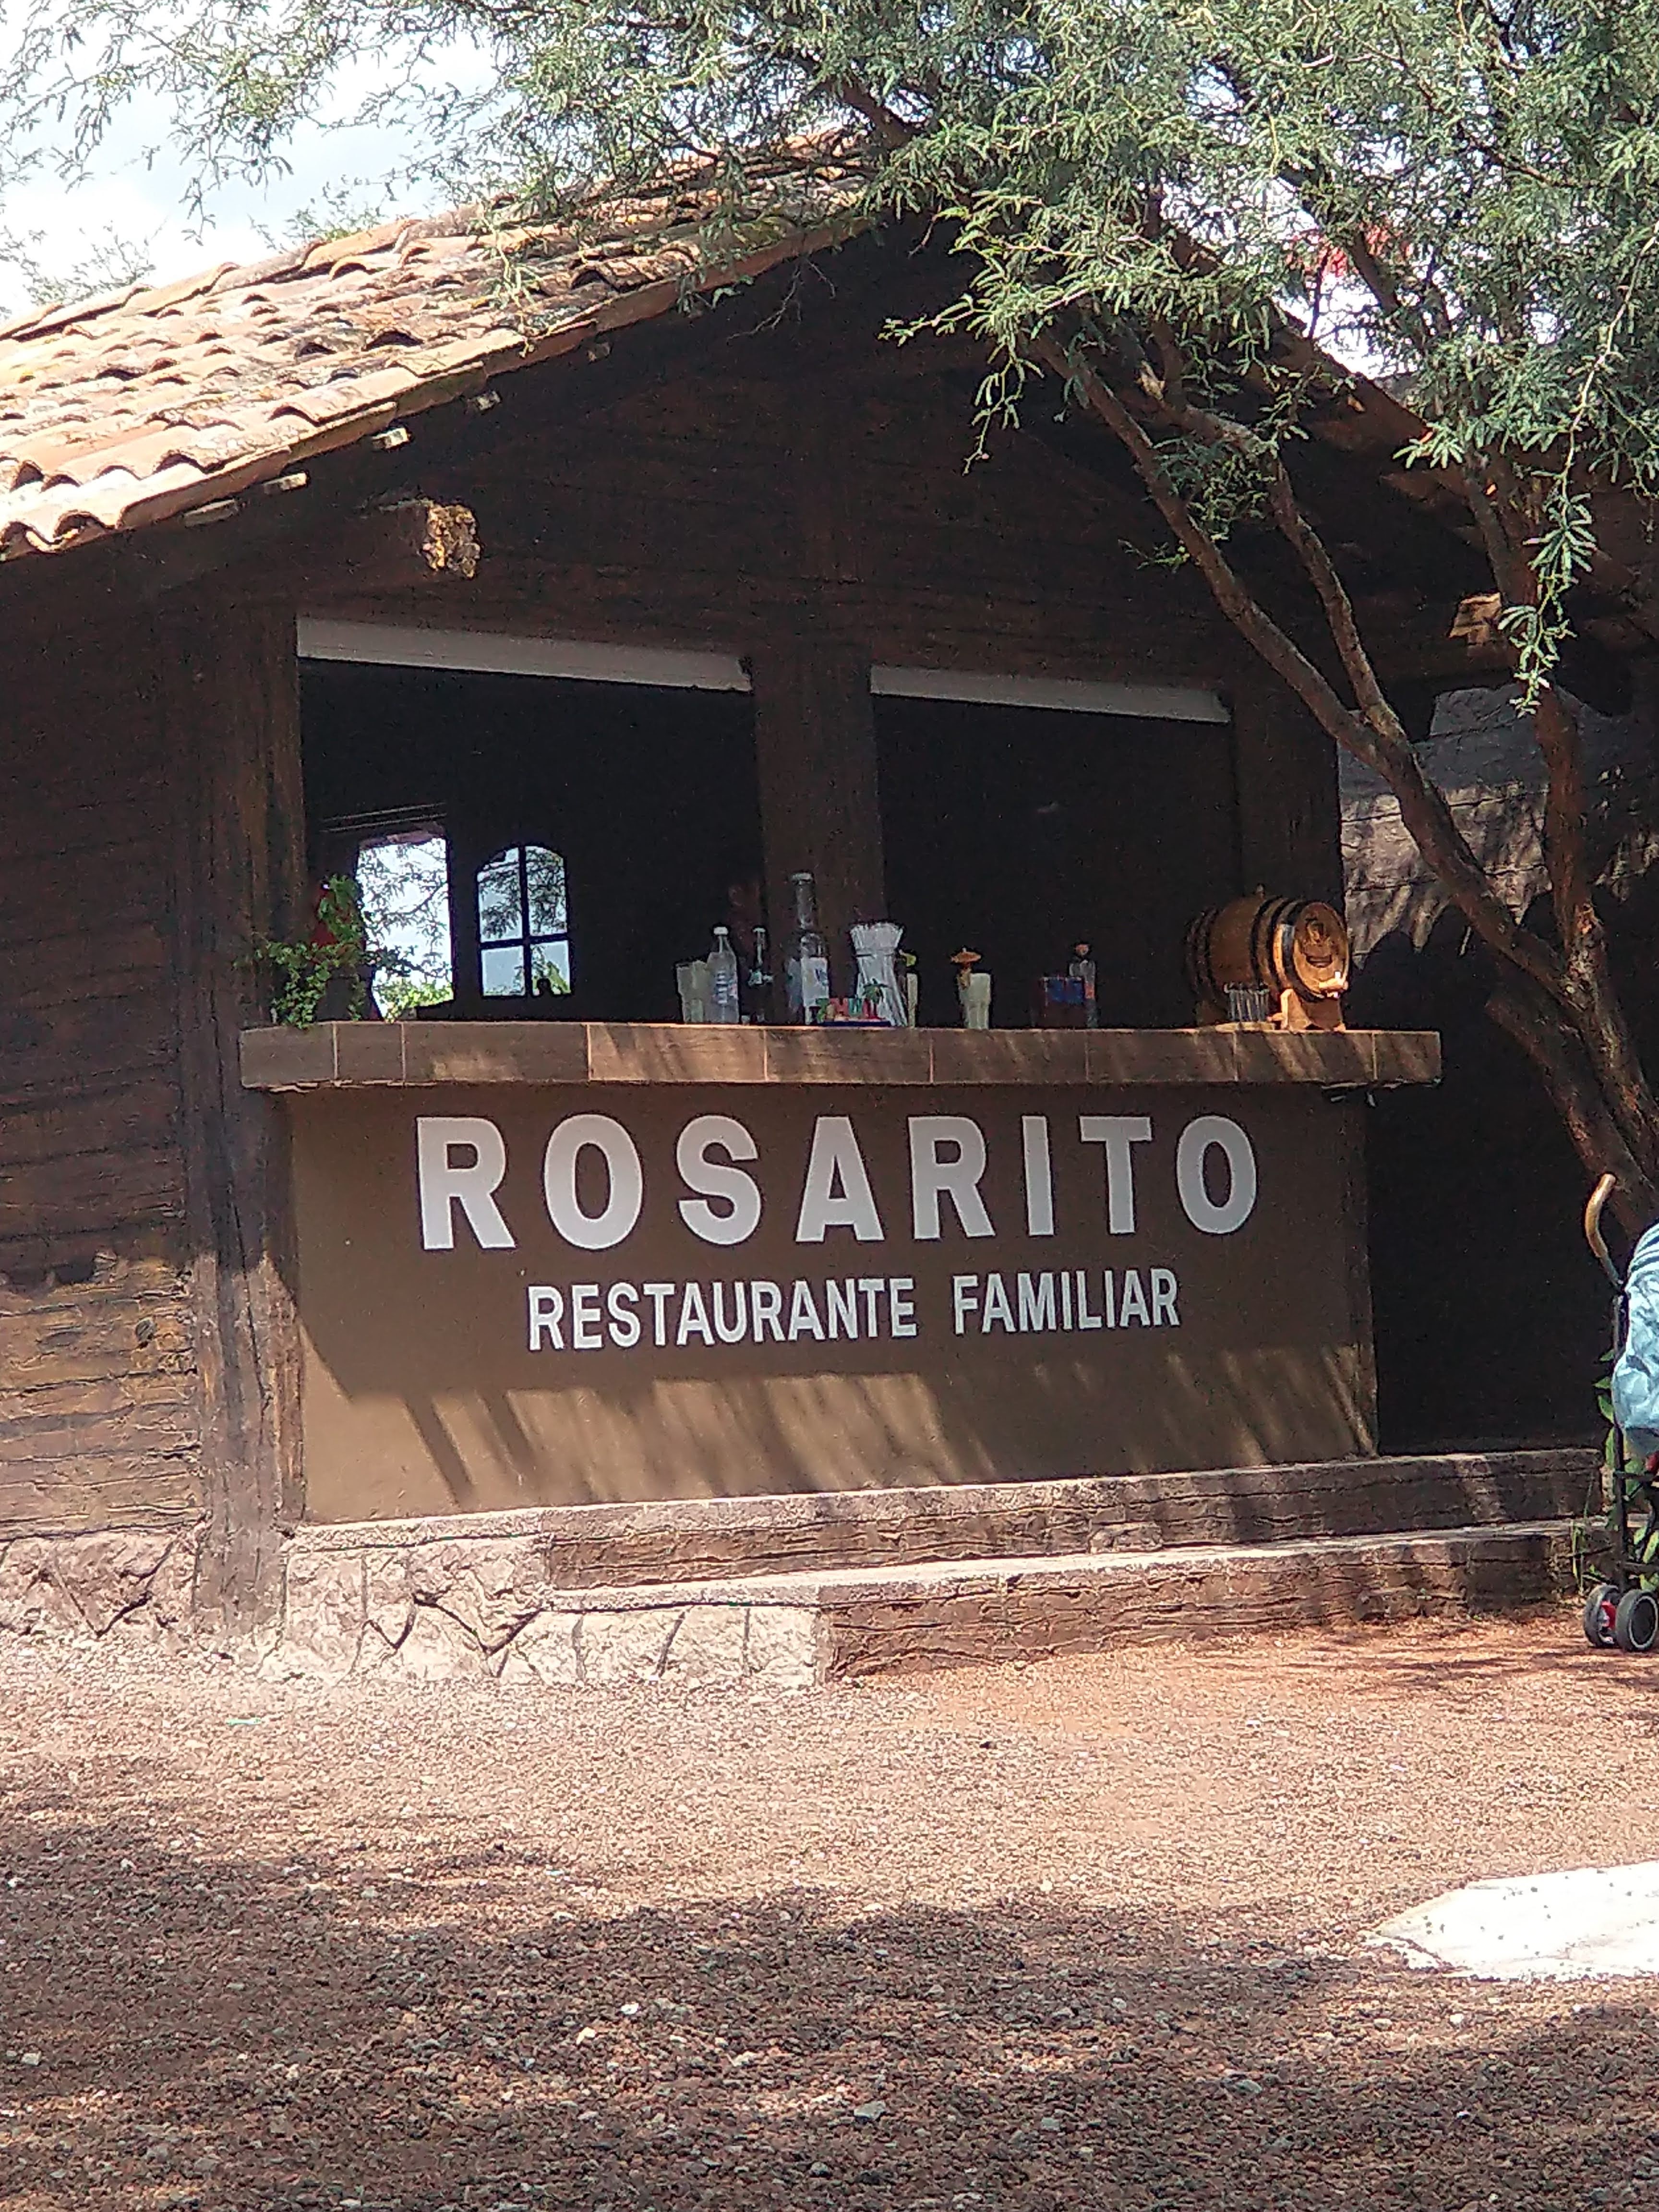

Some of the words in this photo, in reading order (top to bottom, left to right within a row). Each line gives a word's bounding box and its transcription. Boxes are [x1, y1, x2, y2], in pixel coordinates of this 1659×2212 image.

[416, 1113, 1257, 1251] ROSARITO
[528, 1277, 917, 1351] RESTAURANTE
[952, 1268, 1180, 1334] FAMILIAR
